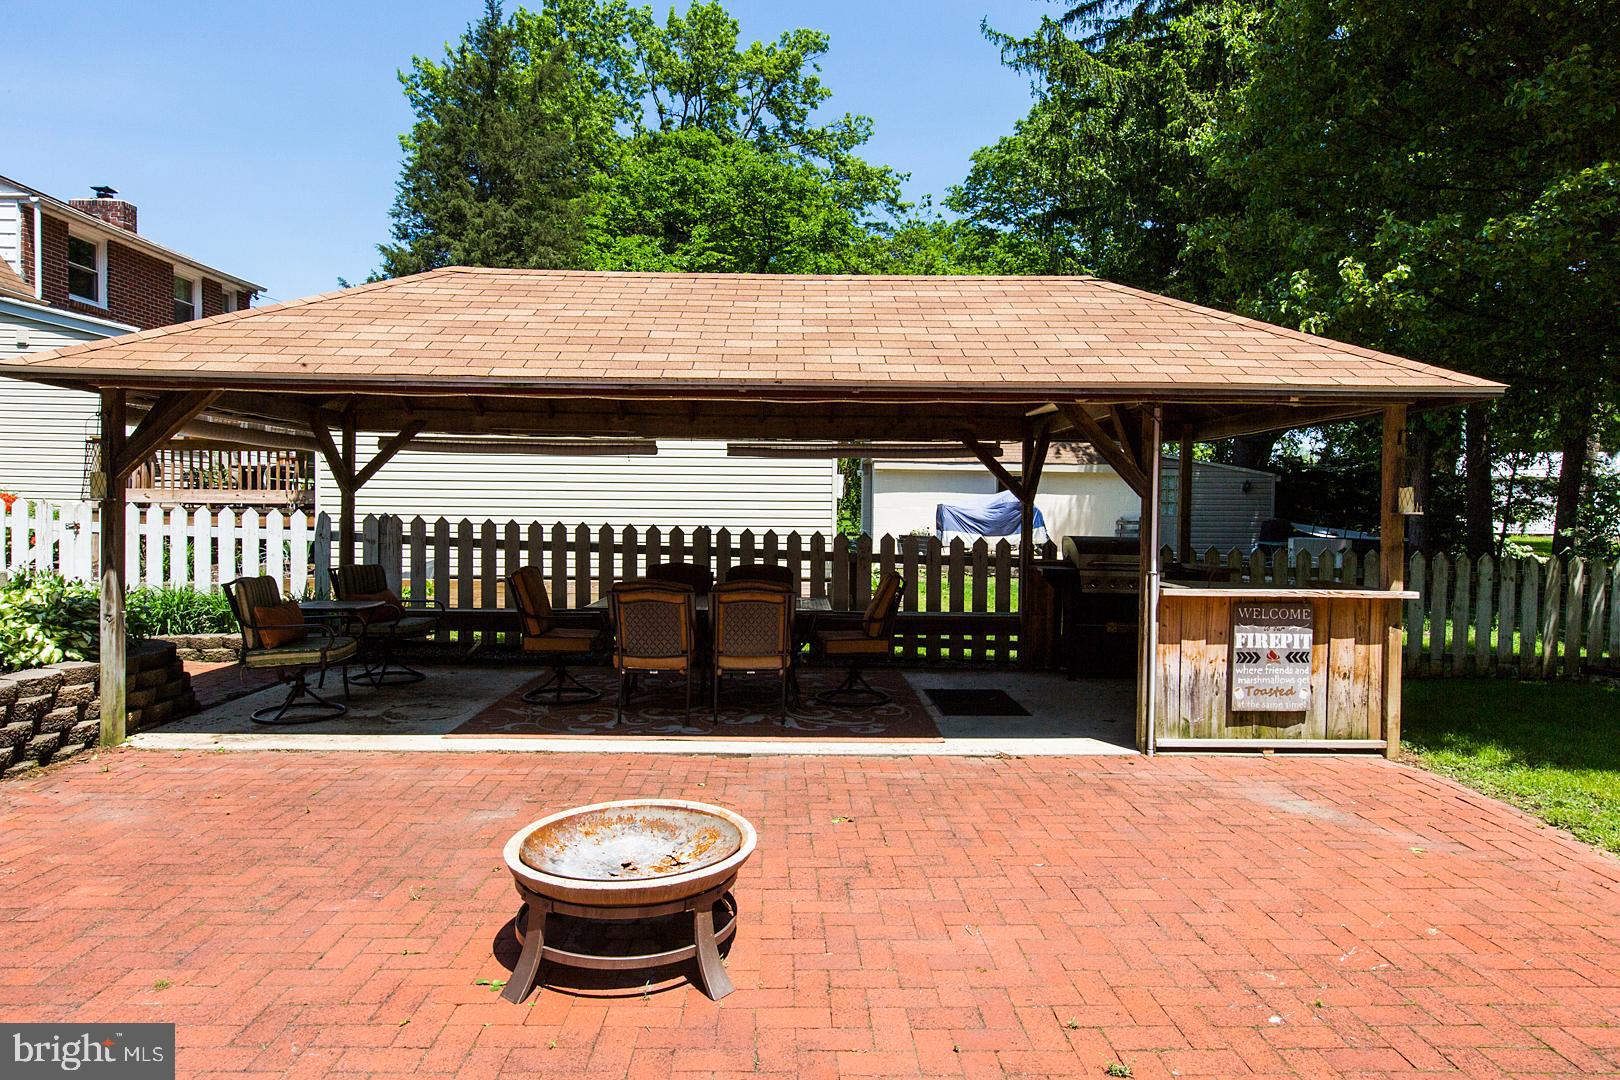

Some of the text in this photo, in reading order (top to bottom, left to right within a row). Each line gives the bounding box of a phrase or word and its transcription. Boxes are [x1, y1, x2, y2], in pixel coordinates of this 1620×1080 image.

[1238, 607, 1311, 620] WELCOME
[1235, 632, 1312, 649] FIREPIT
[1235, 663, 1309, 675] where friends and
[1237, 674, 1310, 685] marshmallows get
[1245, 686, 1297, 698] Toasted
